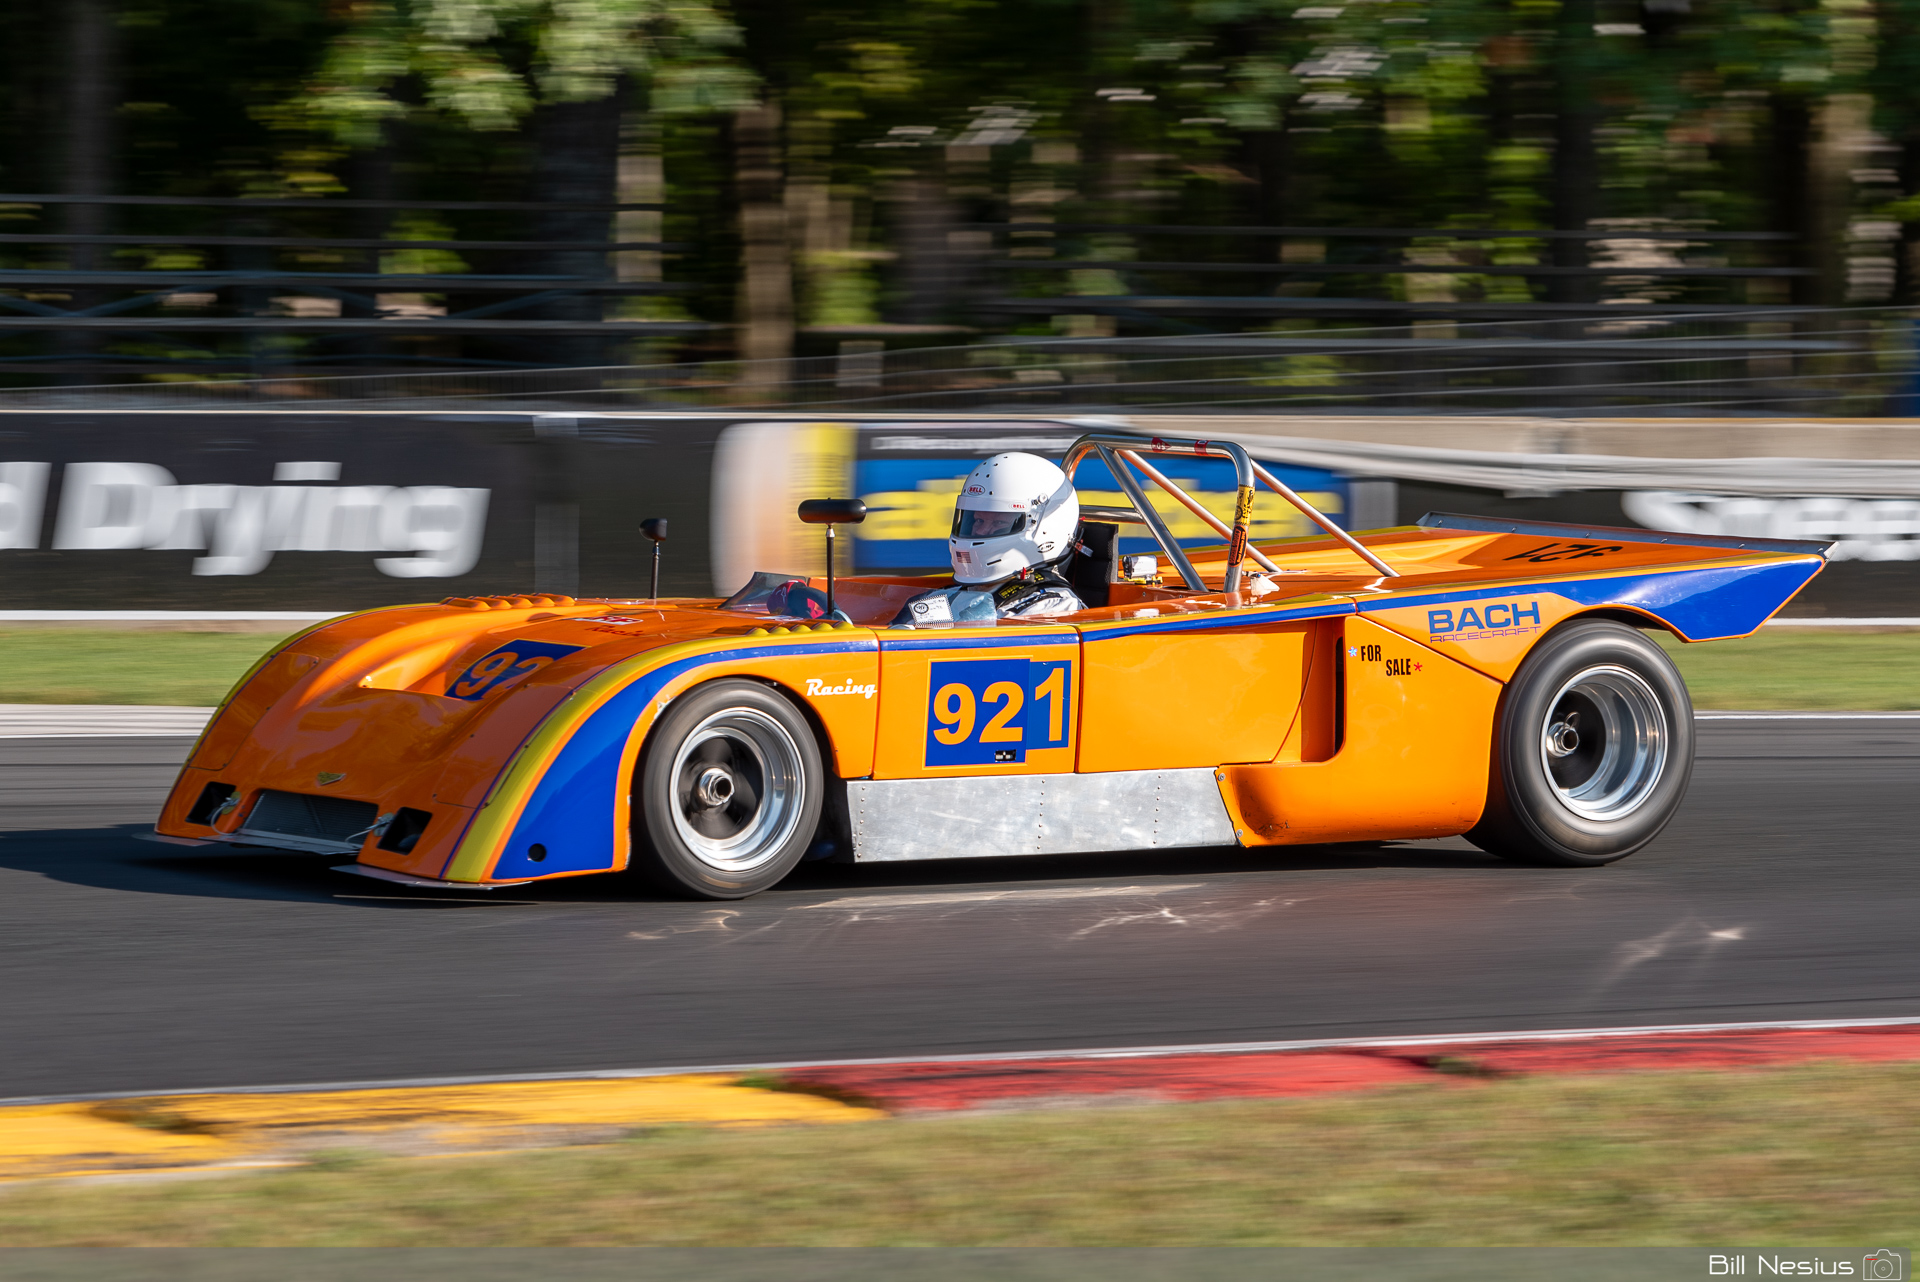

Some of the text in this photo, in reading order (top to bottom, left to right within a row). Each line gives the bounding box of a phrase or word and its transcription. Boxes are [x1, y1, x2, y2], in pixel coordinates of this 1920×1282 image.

[52, 462, 491, 577] Drying
[1428, 601, 1541, 634] BACH
[1430, 626, 1541, 643] RACECRAFT
[1361, 645, 1382, 662] FOR
[1385, 659, 1411, 676] SALE
[806, 678, 877, 699] Racing
[933, 667, 1064, 745] 921
